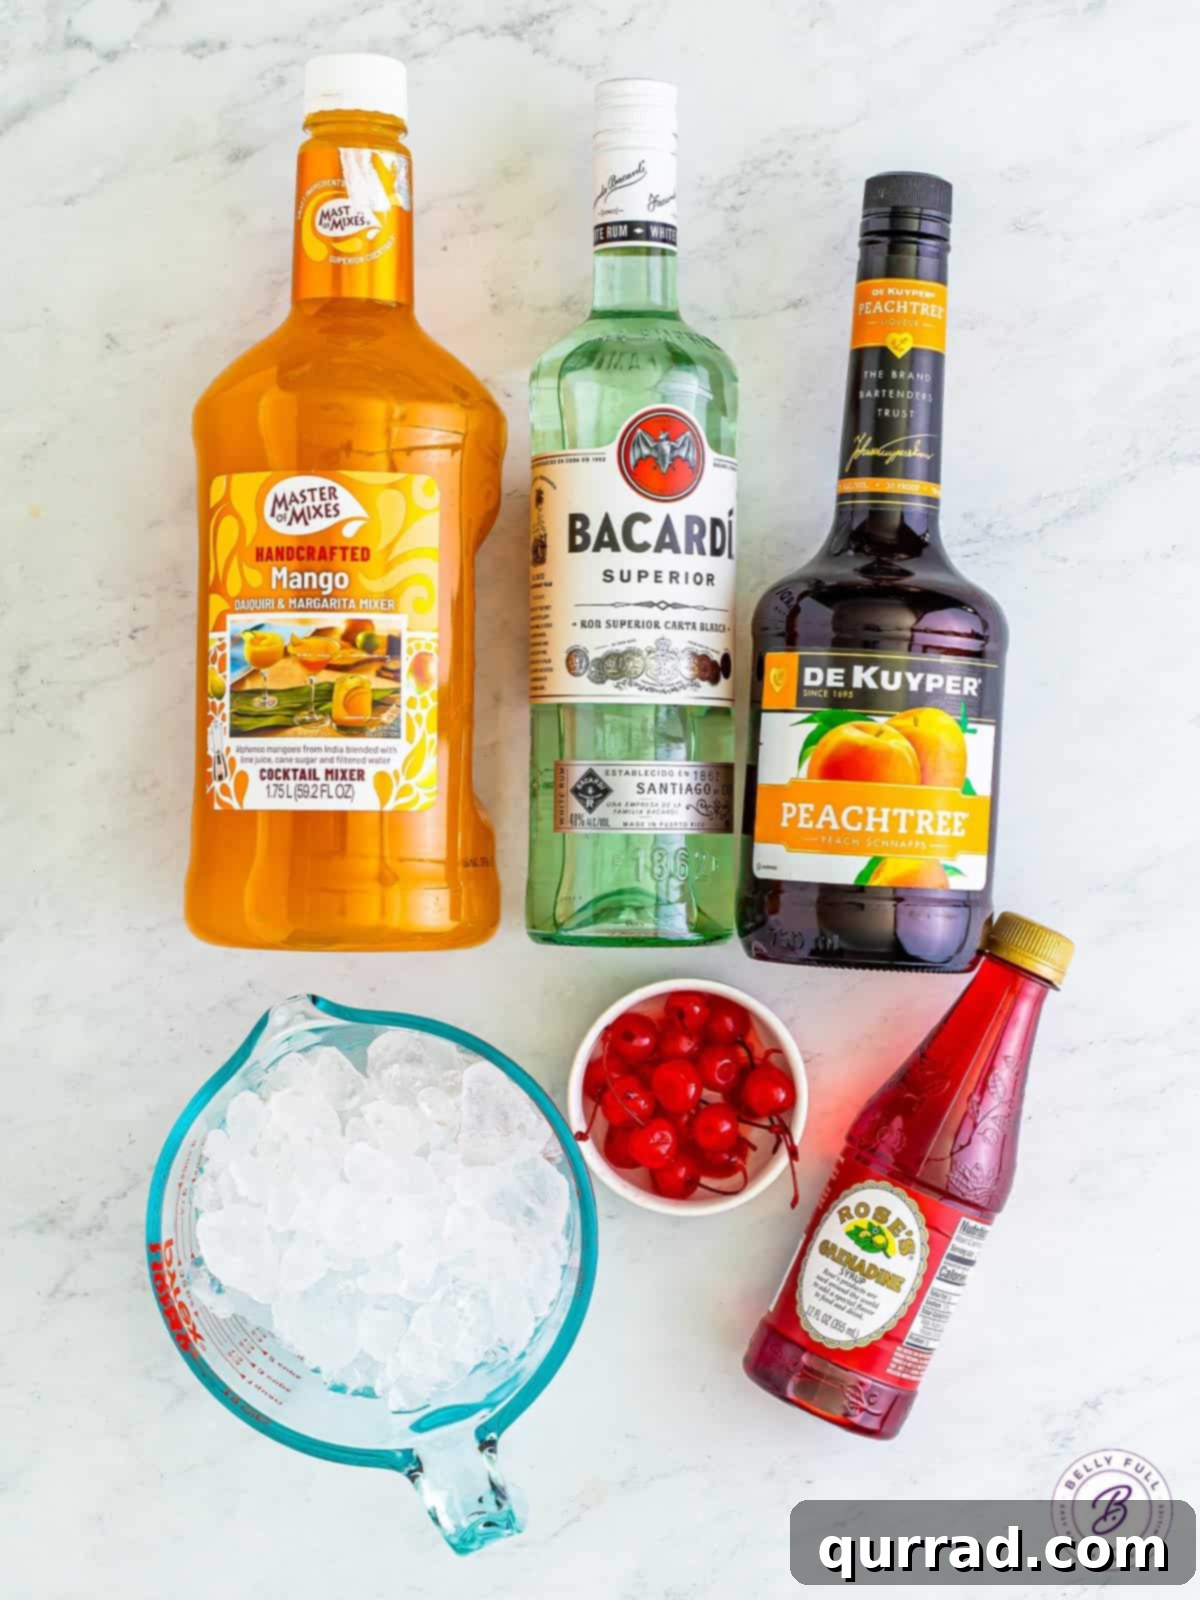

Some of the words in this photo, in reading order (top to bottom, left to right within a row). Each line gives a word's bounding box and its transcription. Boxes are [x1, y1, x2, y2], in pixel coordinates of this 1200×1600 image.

[329, 215, 365, 231] MIXES
[606, 224, 628, 238] RUM
[650, 224, 676, 241] WHITE
[858, 300, 944, 320] PEACHTREE
[863, 370, 884, 379] THE
[892, 370, 932, 382] BRAND
[859, 389, 933, 402] BARTENDERS
[877, 408, 915, 419] TRUST
[270, 486, 338, 517] MASTER
[287, 503, 340, 526] MIXES
[568, 508, 734, 559] BACARDÍ
[256, 547, 371, 563] HANDCRAFTED
[271, 567, 349, 595] Mango
[602, 569, 715, 586] SUPERIOR
[235, 598, 275, 611] DAIQUIRI
[277, 599, 285, 609] &
[289, 597, 356, 610] MARGARITA
[360, 598, 395, 611] MIXER
[605, 619, 661, 630] SUPERIOR
[664, 620, 697, 632] CARTA
[804, 667, 845, 687] DE
[803, 688, 828, 698] SINCE
[266, 746, 301, 755] mangoes
[303, 744, 323, 753] from
[324, 745, 344, 753] India
[345, 745, 379, 753] blended
[380, 746, 398, 754] with
[295, 757, 317, 765] sugar
[319, 756, 335, 764] and
[336, 756, 366, 764] filtered
[259, 768, 320, 781] COCKTAIL
[324, 768, 365, 781] MIXER
[605, 769, 674, 778] ESTABLECIDO
[678, 769, 690, 778] EN
[320, 783, 334, 799] FL
[335, 783, 355, 803] OZ)
[636, 782, 711, 795] SANTIAGO
[780, 802, 969, 837] PEACHTREE
[821, 835, 860, 847] PEACH
[865, 837, 927, 850] SCHNAPPS
[836, 1202, 916, 1257] ROSE'S
[819, 1239, 905, 1293] GRENADINE
[839, 1266, 867, 1285] SYRUP
[820, 1294, 834, 1305] food
[833, 1302, 847, 1312] and
[828, 1281, 850, 1295] around
[860, 1298, 880, 1310] world
[834, 1293, 857, 1307] special
